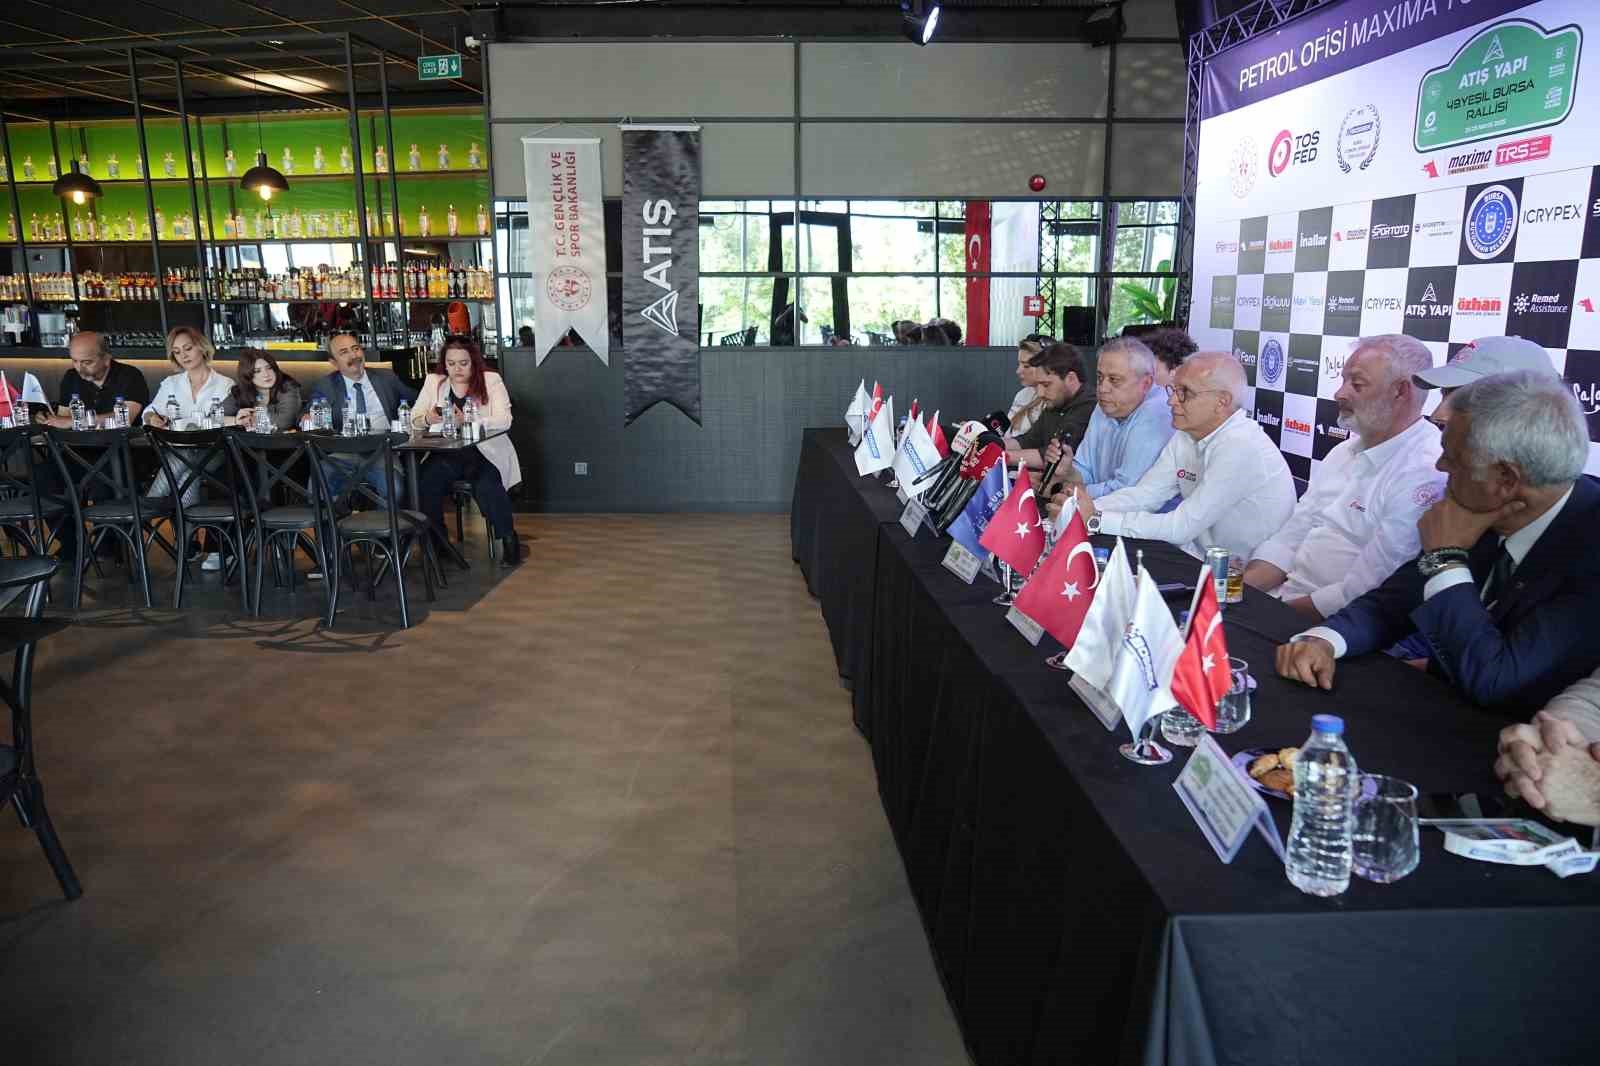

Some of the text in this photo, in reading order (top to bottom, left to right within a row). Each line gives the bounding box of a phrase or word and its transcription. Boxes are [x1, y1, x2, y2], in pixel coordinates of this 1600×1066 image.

[1239, 0, 1437, 91] PETROL OFİSİ MAXIMA
[1458, 68, 1489, 89] ATIŞ
[1494, 56, 1528, 78] YAPI
[1493, 79, 1535, 99] BURSA
[1295, 130, 1320, 149] TOS
[551, 152, 561, 169] VE
[1293, 148, 1318, 165] FED
[1448, 148, 1492, 169] maxima
[551, 173, 566, 231] GENÇLİK
[1522, 204, 1582, 224] ICRYPEX
[569, 224, 580, 257] SPOR
[642, 199, 677, 291] ATIŞ
[1530, 303, 1569, 313] Assistance
[1531, 294, 1560, 303] Remed
[1406, 304, 1428, 317] ATIŞ
[1429, 304, 1453, 316] YAPI
